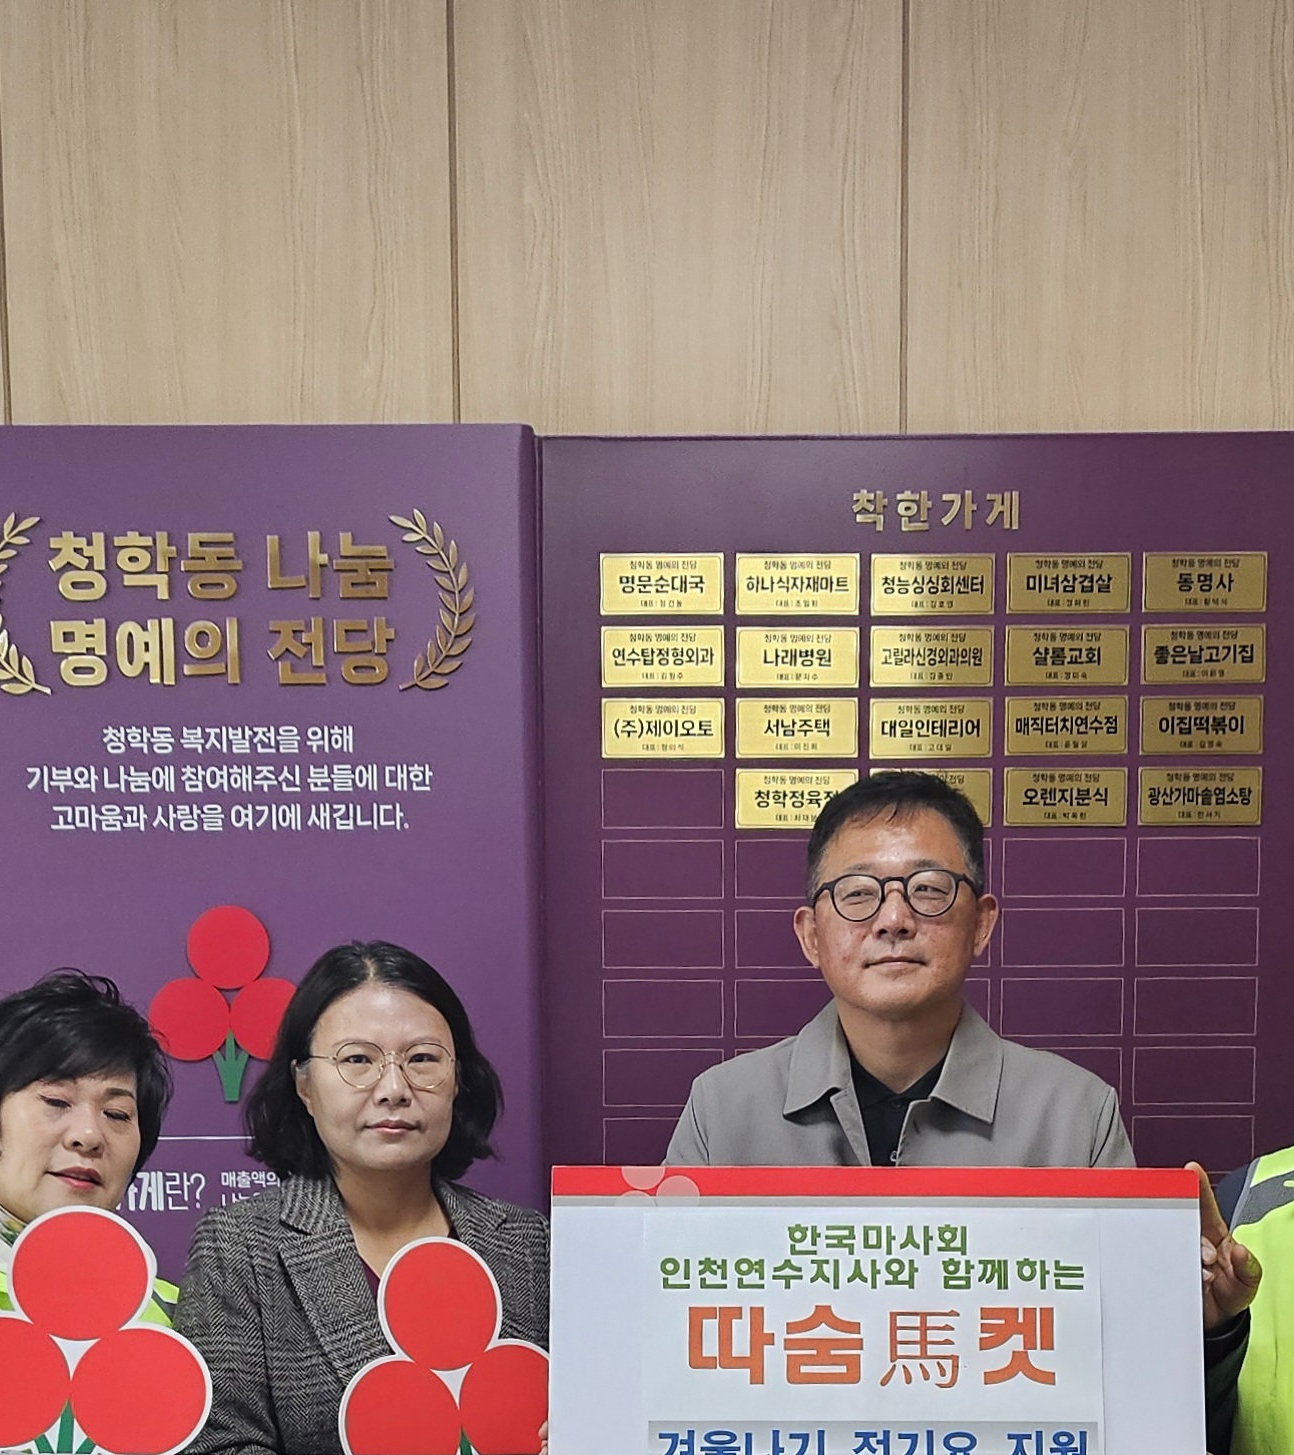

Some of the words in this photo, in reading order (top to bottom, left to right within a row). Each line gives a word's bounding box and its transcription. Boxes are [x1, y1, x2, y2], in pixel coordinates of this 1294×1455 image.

[852, 489, 1020, 532] 착한가게
[48, 531, 244, 602] 청학동
[266, 530, 396, 600] 나눔
[619, 575, 705, 594] 명문순대국
[746, 575, 849, 593] 하나식자재마트
[881, 575, 985, 595] 청능싱싱회센터
[1026, 573, 1113, 594] 미녀삼겹살
[1176, 572, 1235, 593] 동명사
[48, 616, 241, 688] 명예의
[267, 616, 396, 686] 전당
[612, 646, 715, 667] 연수탑정형외과
[763, 648, 832, 667] 나래병원
[881, 647, 983, 667] 고릴라신경외과의원
[1154, 643, 1255, 665] 좋은날고기집
[613, 718, 714, 739] (주)제이오토
[764, 718, 830, 737] 서남주택
[880, 717, 981, 739] 대일인테리어
[1015, 715, 1118, 735] 매직터치연수점
[1158, 715, 1245, 735] 이집떡볶이
[102, 725, 175, 754] 청학동
[179, 725, 301, 754] 복지발전을
[305, 725, 354, 754] 위해
[25, 765, 98, 794] 기부와
[102, 765, 175, 794] 나눔에
[180, 764, 302, 794] 참여해주신
[307, 764, 379, 793] 분들에
[385, 763, 433, 792] 대한
[1022, 787, 1109, 807] 오렌지분식
[49, 804, 146, 832] 고마움과
[152, 804, 225, 832] 사랑을
[230, 803, 301, 832] 여기에
[306, 802, 410, 831] 새깁니다.
[787, 1223, 970, 1257] 한국마사회
[658, 1257, 919, 1291] 인천연수지사와
[941, 1258, 1086, 1292] 함께하는
[687, 1303, 1057, 1390] 따숨馬켓
